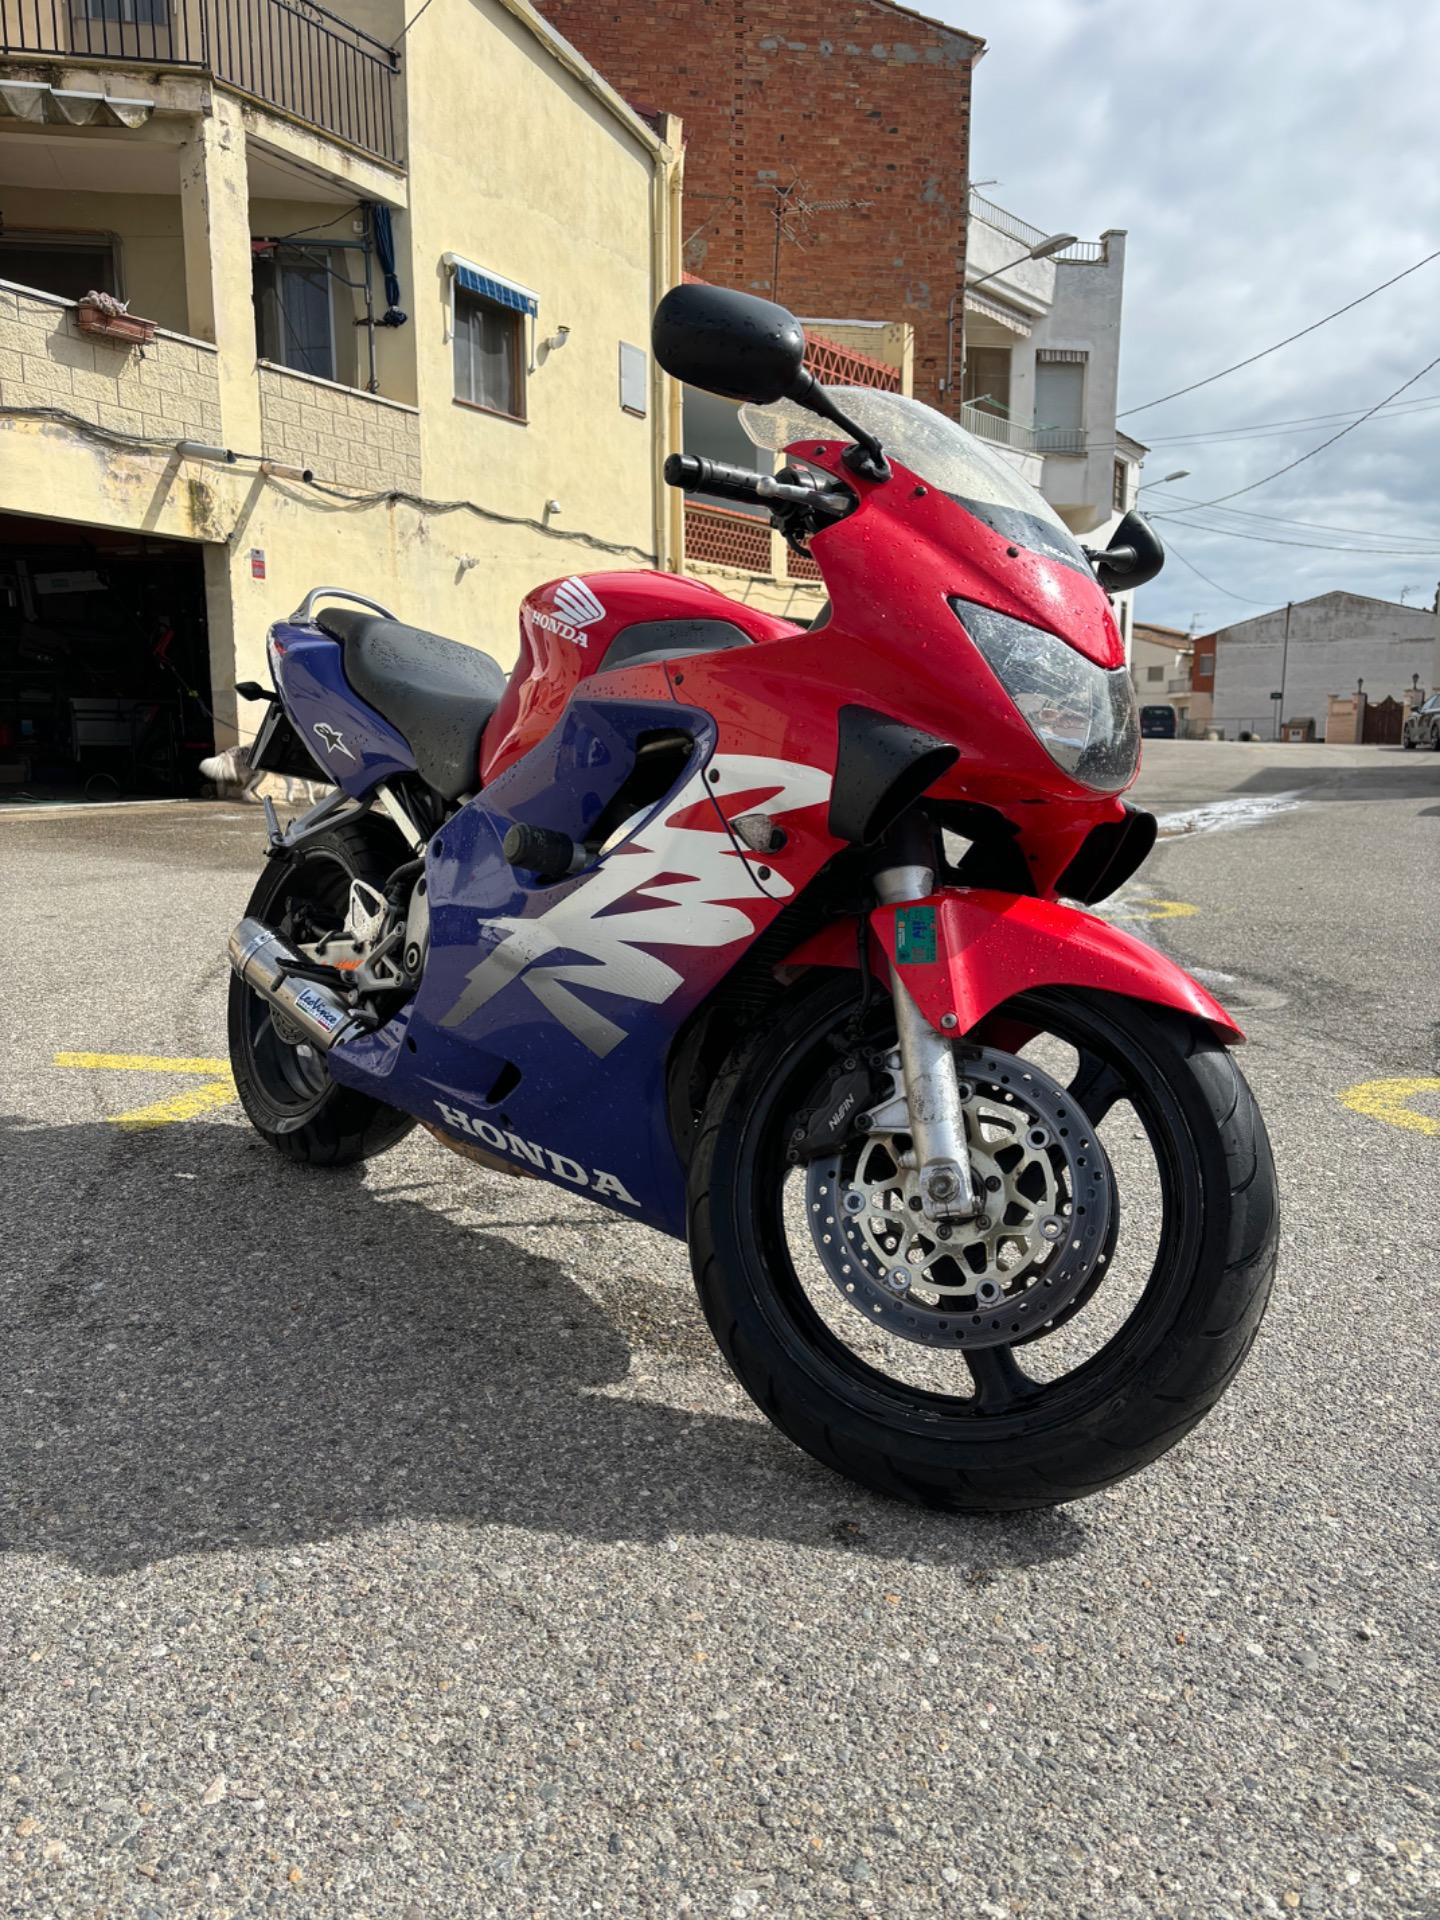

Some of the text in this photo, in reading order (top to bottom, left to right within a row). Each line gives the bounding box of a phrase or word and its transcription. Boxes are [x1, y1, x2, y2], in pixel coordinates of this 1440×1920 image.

[531, 610, 588, 648] HONDA
[299, 989, 338, 1024] LeoVince
[433, 1100, 642, 1207] HONDA
